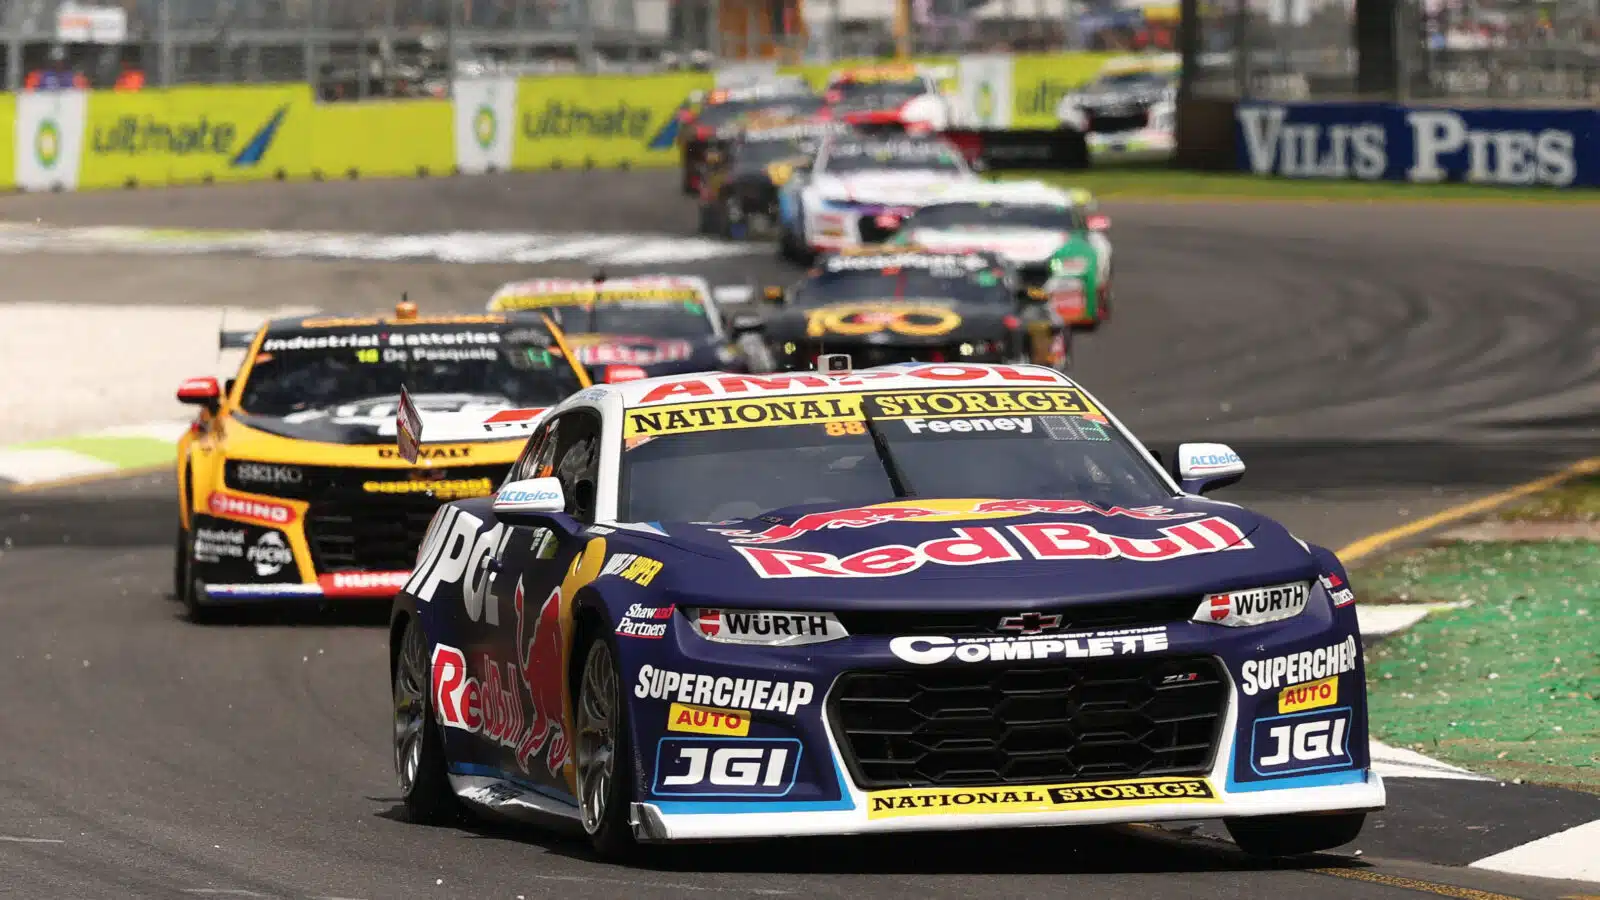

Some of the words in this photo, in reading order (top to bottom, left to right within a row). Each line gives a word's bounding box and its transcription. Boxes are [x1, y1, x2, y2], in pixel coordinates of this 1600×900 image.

[92, 114, 236, 154] ultimate
[522, 99, 650, 139] ultimate
[1406, 109, 1578, 187] PIES
[263, 333, 379, 351] Industrial
[388, 331, 500, 347] Batteries
[383, 348, 408, 363] De
[412, 347, 499, 362] Pasquale
[631, 399, 858, 433] NATIONAL
[873, 389, 1082, 418] STORAGE
[825, 420, 866, 437] 88
[907, 416, 1034, 435] Feeney
[236, 464, 303, 484] SEIKO
[229, 500, 290, 522] HINO
[497, 490, 559, 502] ACDelco
[731, 522, 1023, 579] Red
[1004, 516, 1255, 562] Bull
[1235, 584, 1304, 616] WÜRTH
[615, 617, 668, 637] Partners
[725, 613, 829, 636] WÜRTH
[1018, 632, 1094, 642] EQUIPMENT
[1096, 625, 1168, 637] SOLUTIONS
[889, 632, 1169, 665] COMPLETE
[1241, 633, 1357, 696] SUPERCHEAP
[431, 643, 496, 738] Red
[634, 663, 815, 716] SUPERCHEAP
[1284, 683, 1332, 706] AUTO
[675, 710, 742, 730] AUTO
[1259, 717, 1347, 767] JGI
[663, 747, 789, 787] JGI
[872, 790, 1044, 812] NATIONAL
[1052, 781, 1206, 802] STORAGE
